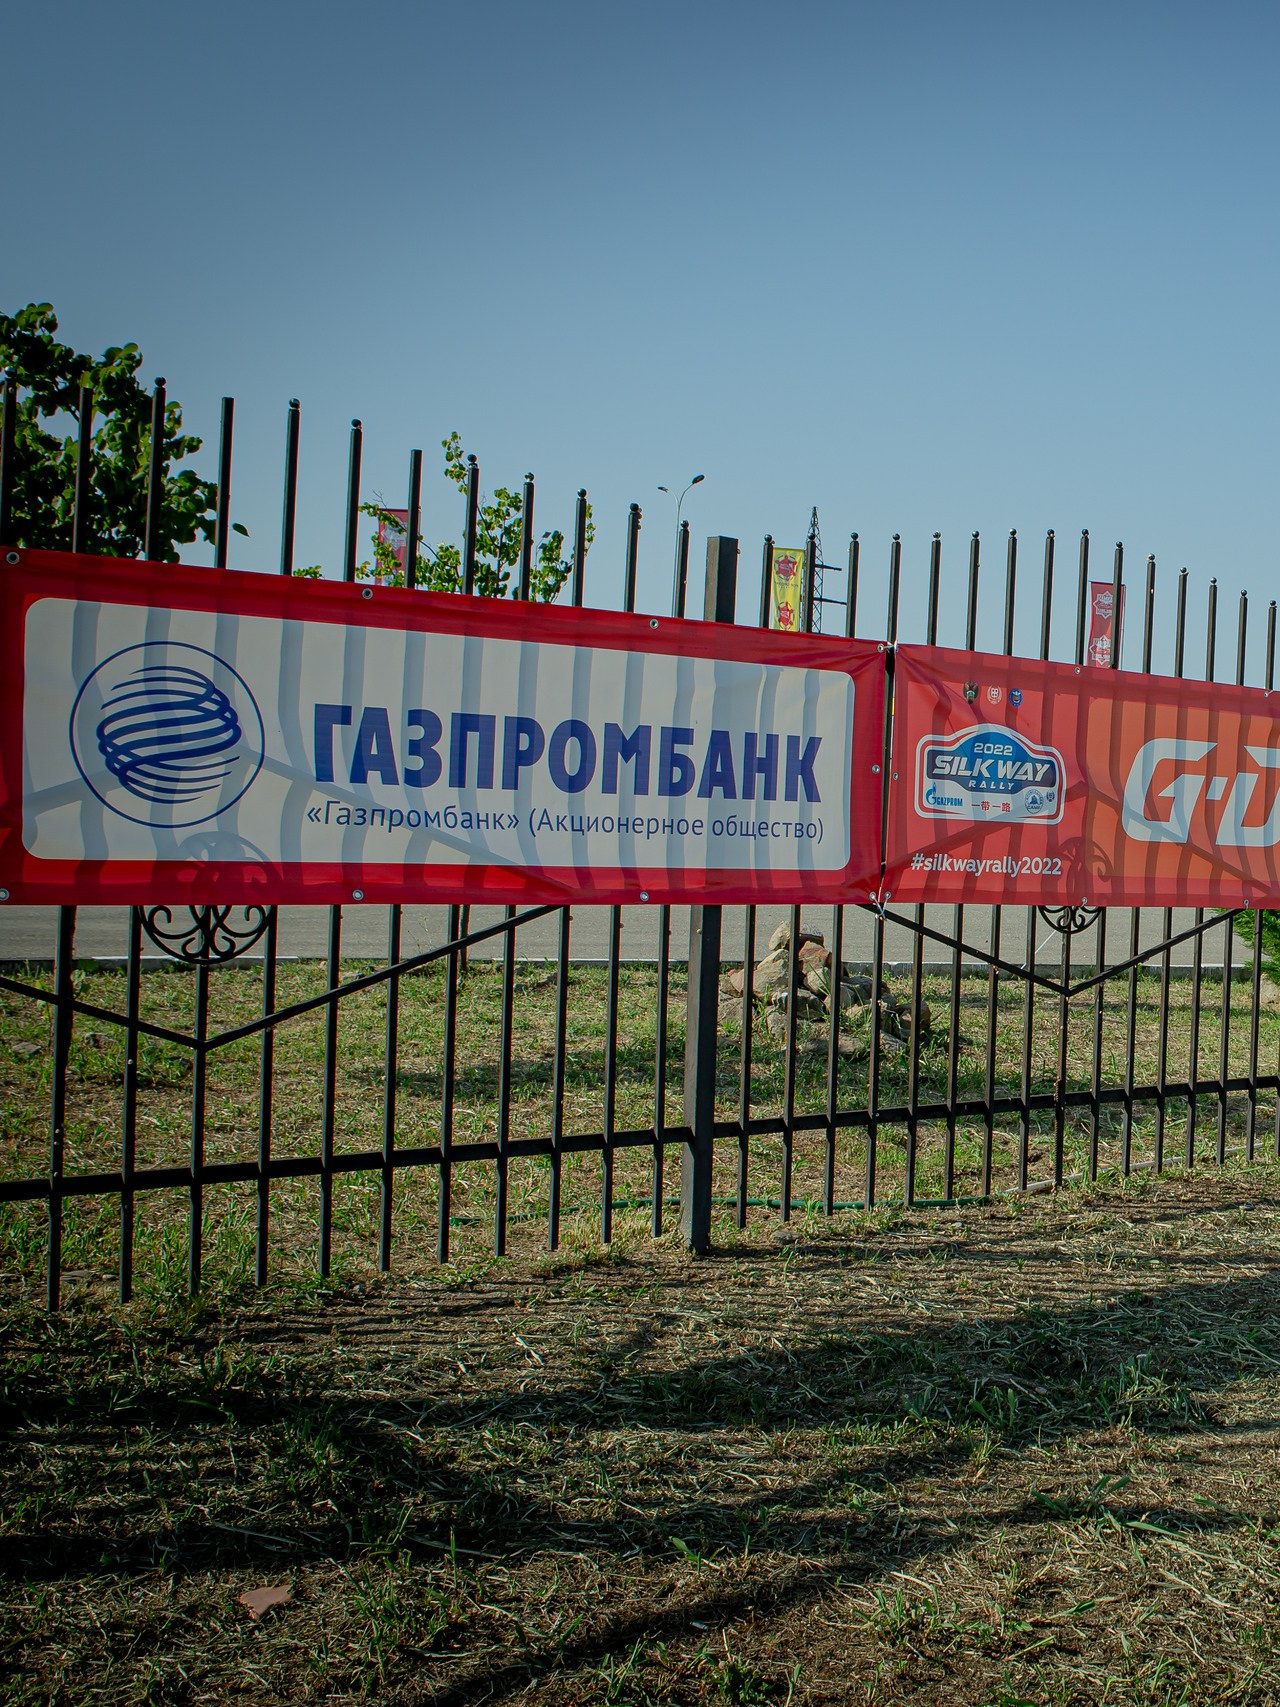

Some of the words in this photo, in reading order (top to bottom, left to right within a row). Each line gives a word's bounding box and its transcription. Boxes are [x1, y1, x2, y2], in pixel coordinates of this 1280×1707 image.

[314, 703, 823, 803] ГАЗПРОМБАНК
[973, 742, 1013, 756] 2022
[932, 755, 994, 778] SILK
[997, 758, 1050, 782] WAY
[968, 779, 1015, 790] RALLY
[307, 800, 519, 833] «Газпромбанк»
[529, 807, 703, 839] (Акционерное
[712, 814, 824, 844] общество)
[910, 853, 1062, 878] #silkwayrally2022
